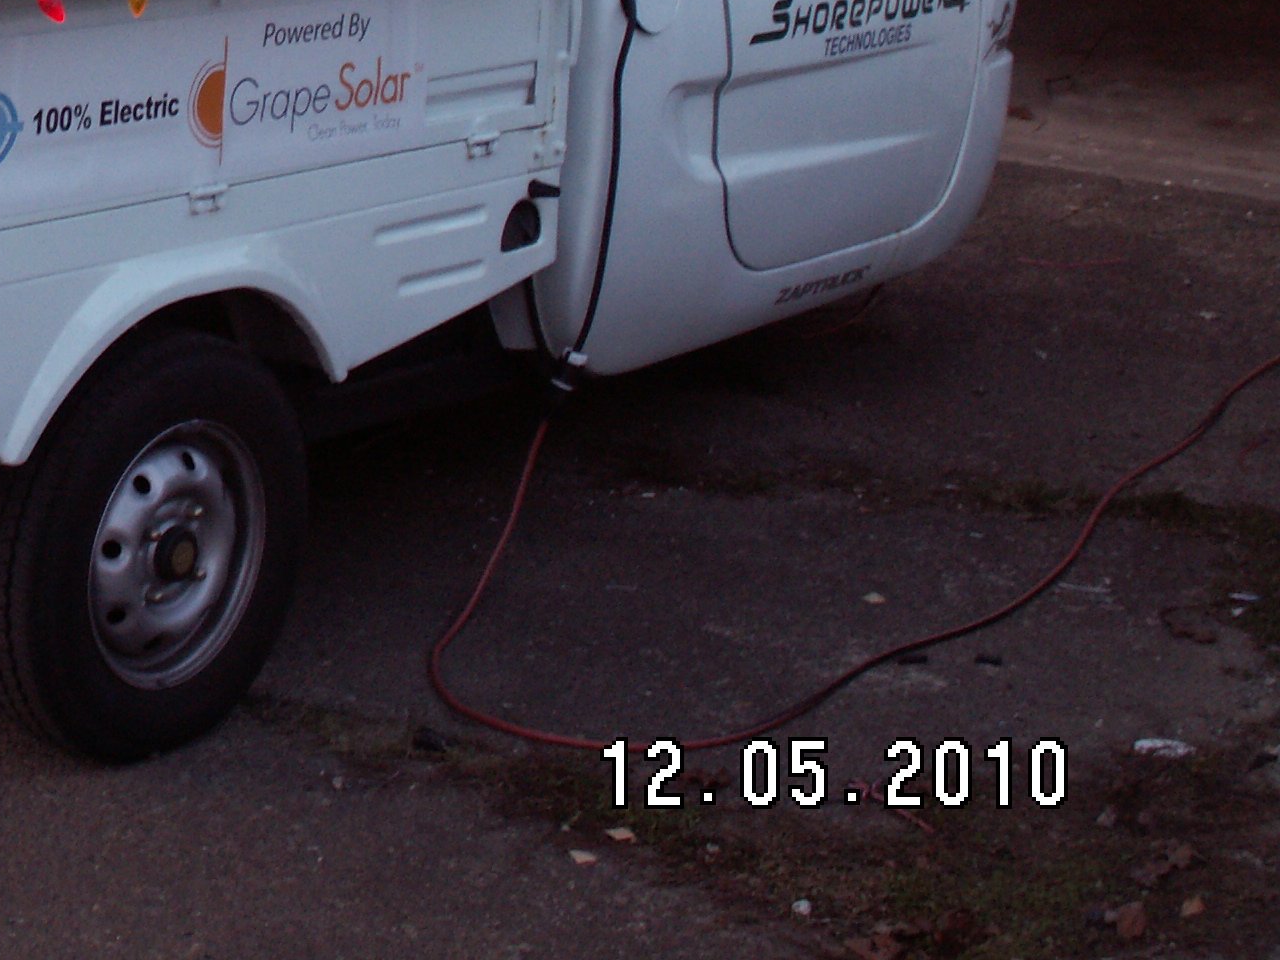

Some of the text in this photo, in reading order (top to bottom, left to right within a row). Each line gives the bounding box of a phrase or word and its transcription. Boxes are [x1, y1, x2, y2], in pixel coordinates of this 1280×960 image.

[262, 12, 371, 48] Powered By
[824, 23, 912, 57] TECHNOLOGIES
[32, 92, 180, 136] 100% Electric
[229, 55, 412, 134] Grape Solar
